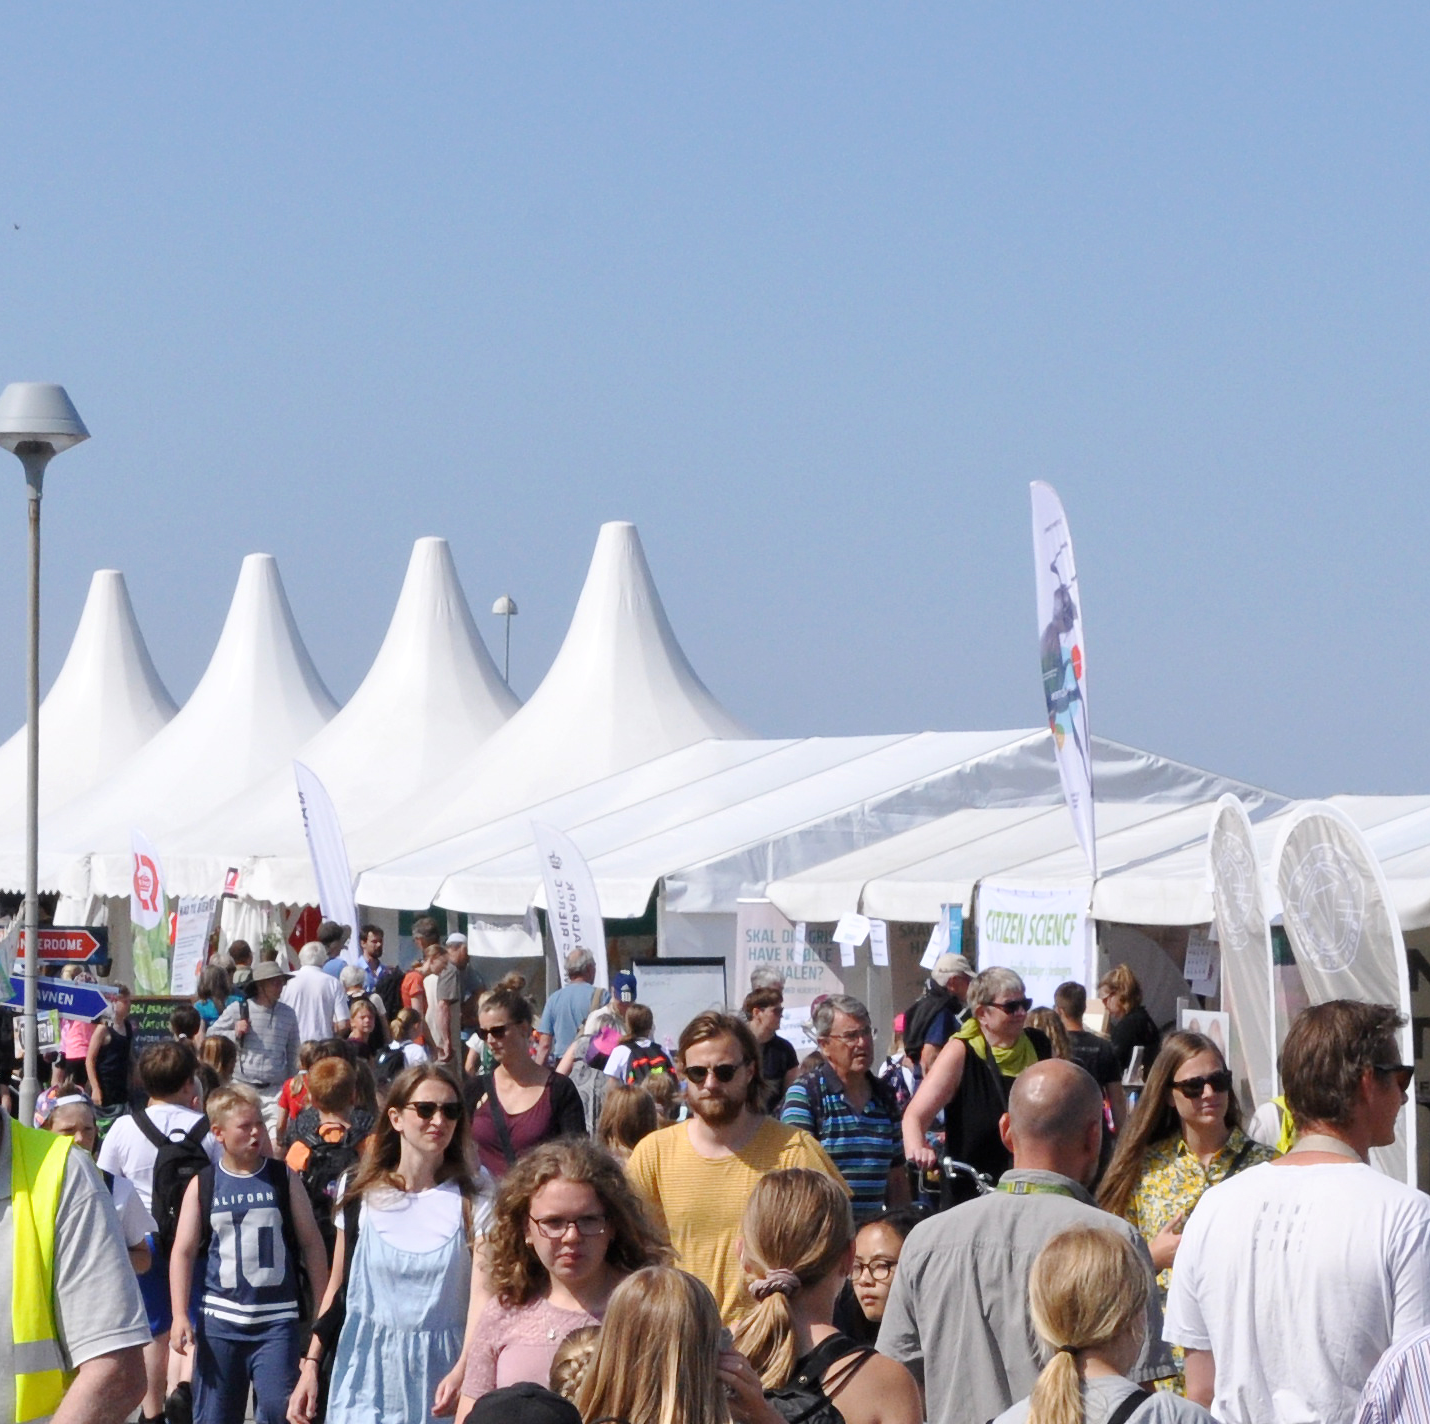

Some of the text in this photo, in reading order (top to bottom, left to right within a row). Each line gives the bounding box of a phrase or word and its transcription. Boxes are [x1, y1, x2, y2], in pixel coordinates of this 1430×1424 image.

[986, 909, 1077, 946] CITIZEN SCIENCE
[746, 929, 777, 943] SKAL
[782, 929, 799, 943] DI
[748, 947, 833, 962] HAVE KØLLE
[36, 989, 74, 1006] AVNEN
[213, 1191, 275, 1207] ALIFORN
[210, 1207, 286, 1289] 10
